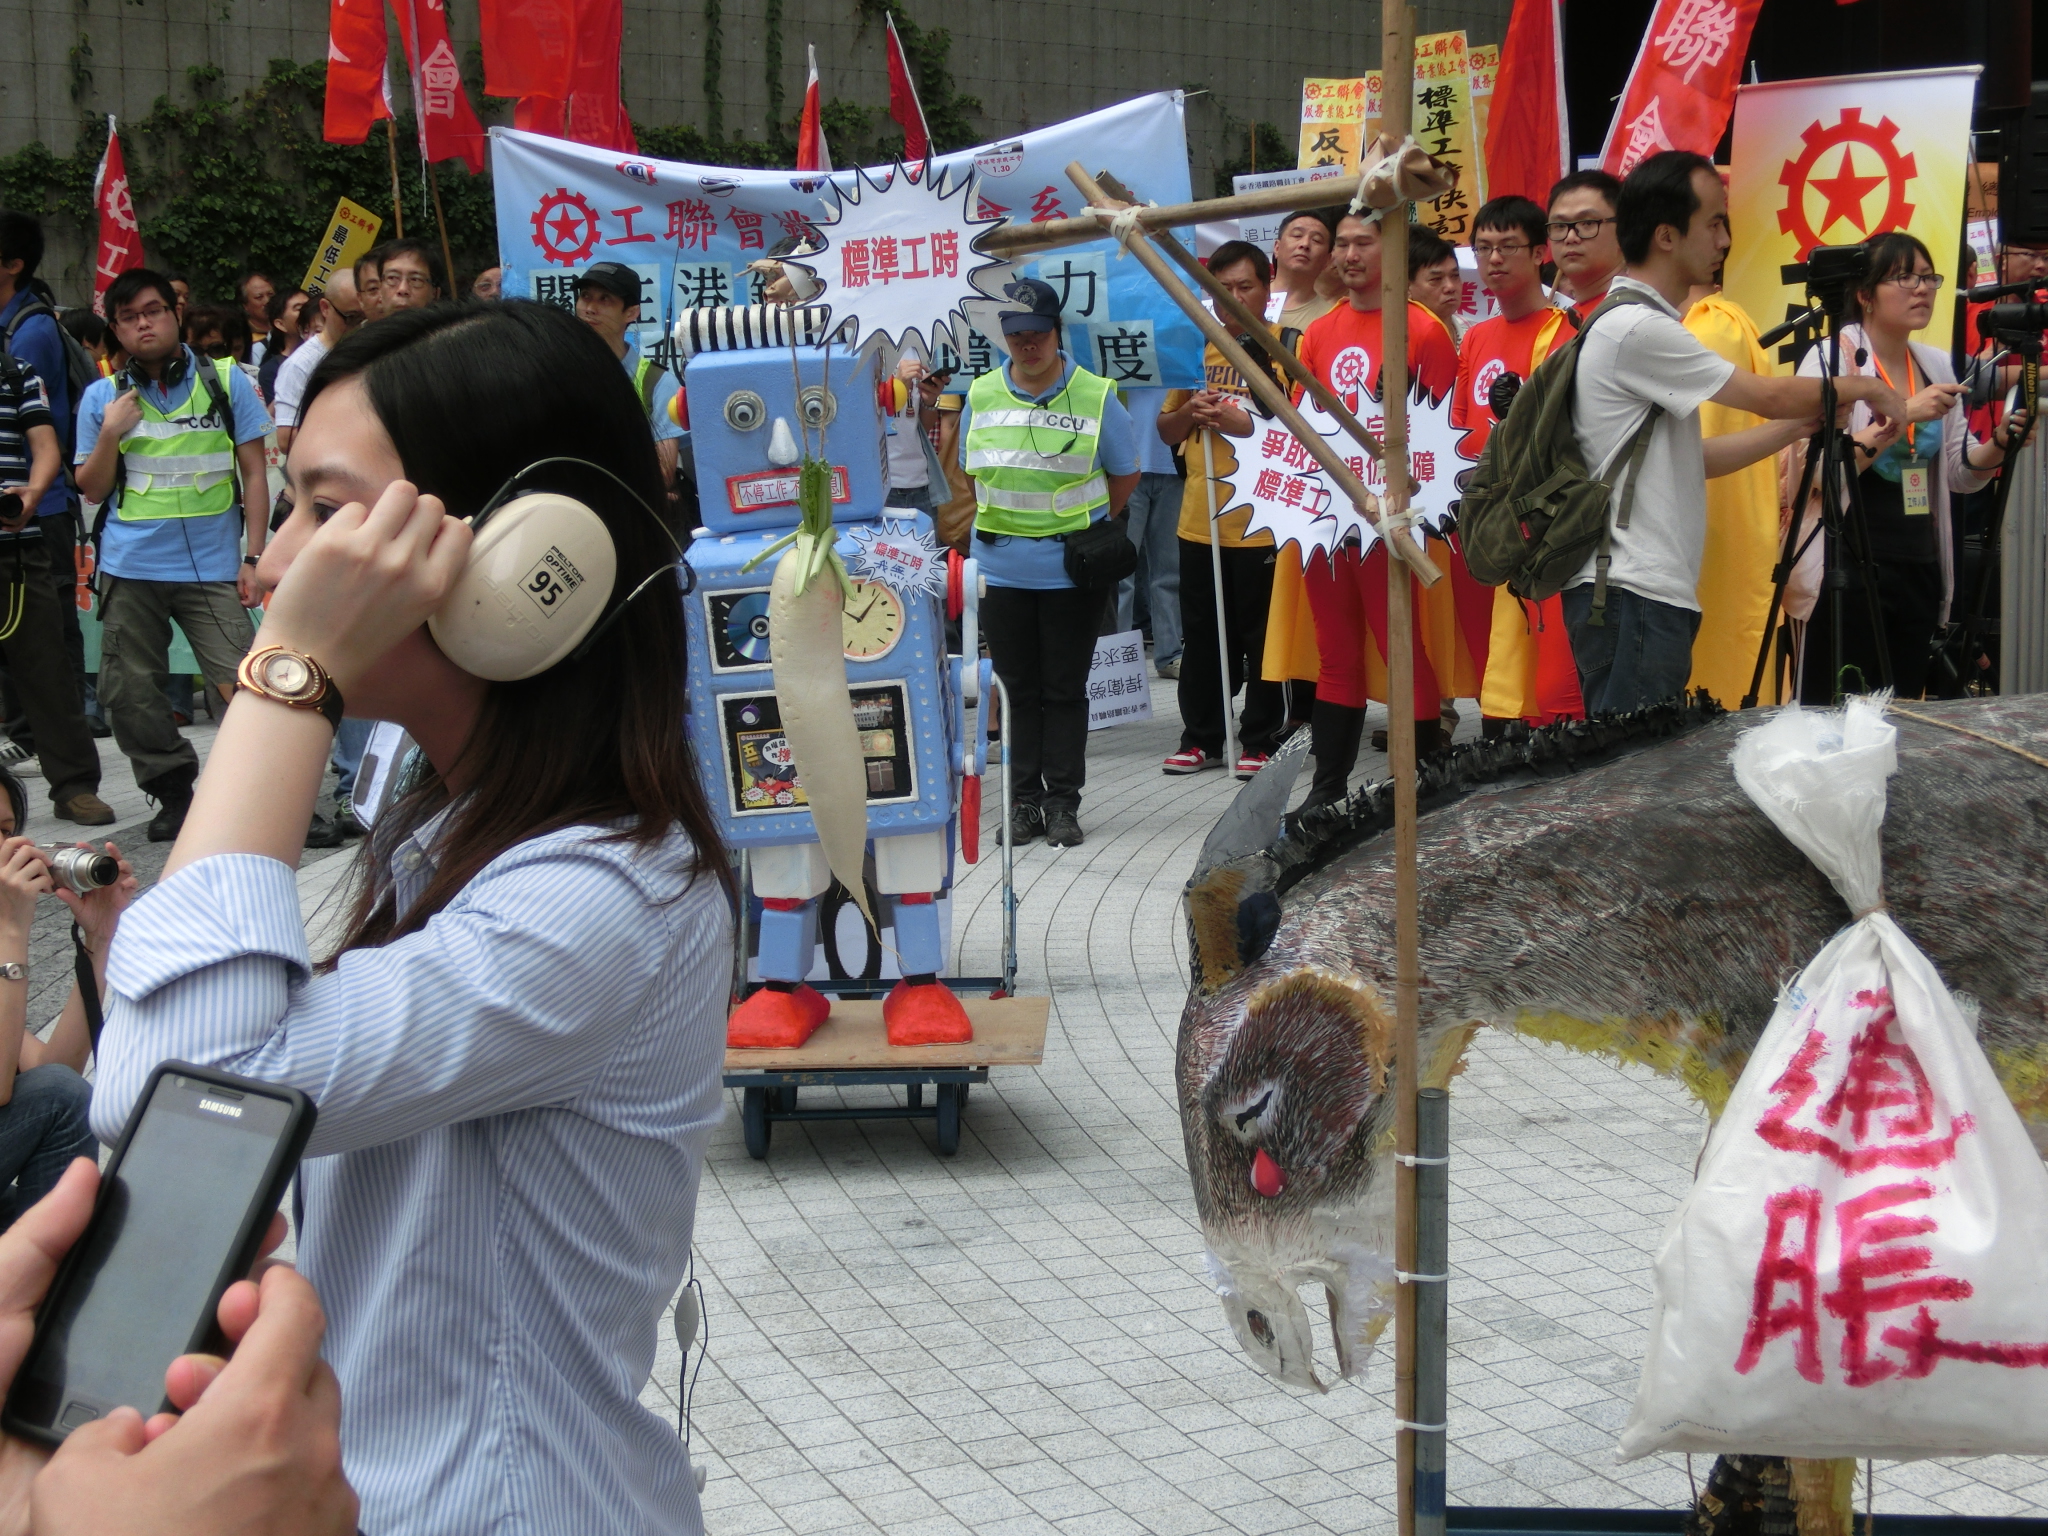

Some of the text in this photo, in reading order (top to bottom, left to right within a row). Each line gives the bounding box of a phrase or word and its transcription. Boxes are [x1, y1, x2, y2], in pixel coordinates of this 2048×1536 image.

[1421, 35, 1466, 57] 工聯會
[422, 0, 460, 119] 會
[1322, 82, 1365, 101] 工聯會
[1472, 74, 1496, 90] 服務
[992, 165, 1011, 173] 1.30
[349, 214, 375, 234] 工聯會
[841, 229, 959, 288] 標準工時
[1046, 260, 1097, 317] 力
[1097, 327, 1153, 382] 度
[2026, 362, 2037, 393] Nikon
[188, 415, 221, 429] CCU
[1046, 414, 1085, 431] CCU
[741, 480, 788, 503] 不停工作
[551, 545, 586, 582] PELTOR
[873, 541, 924, 571] 標準工時
[545, 554, 578, 589] OPTIME
[528, 571, 564, 606] 95
[199, 1098, 243, 1118] SAMSUNG
